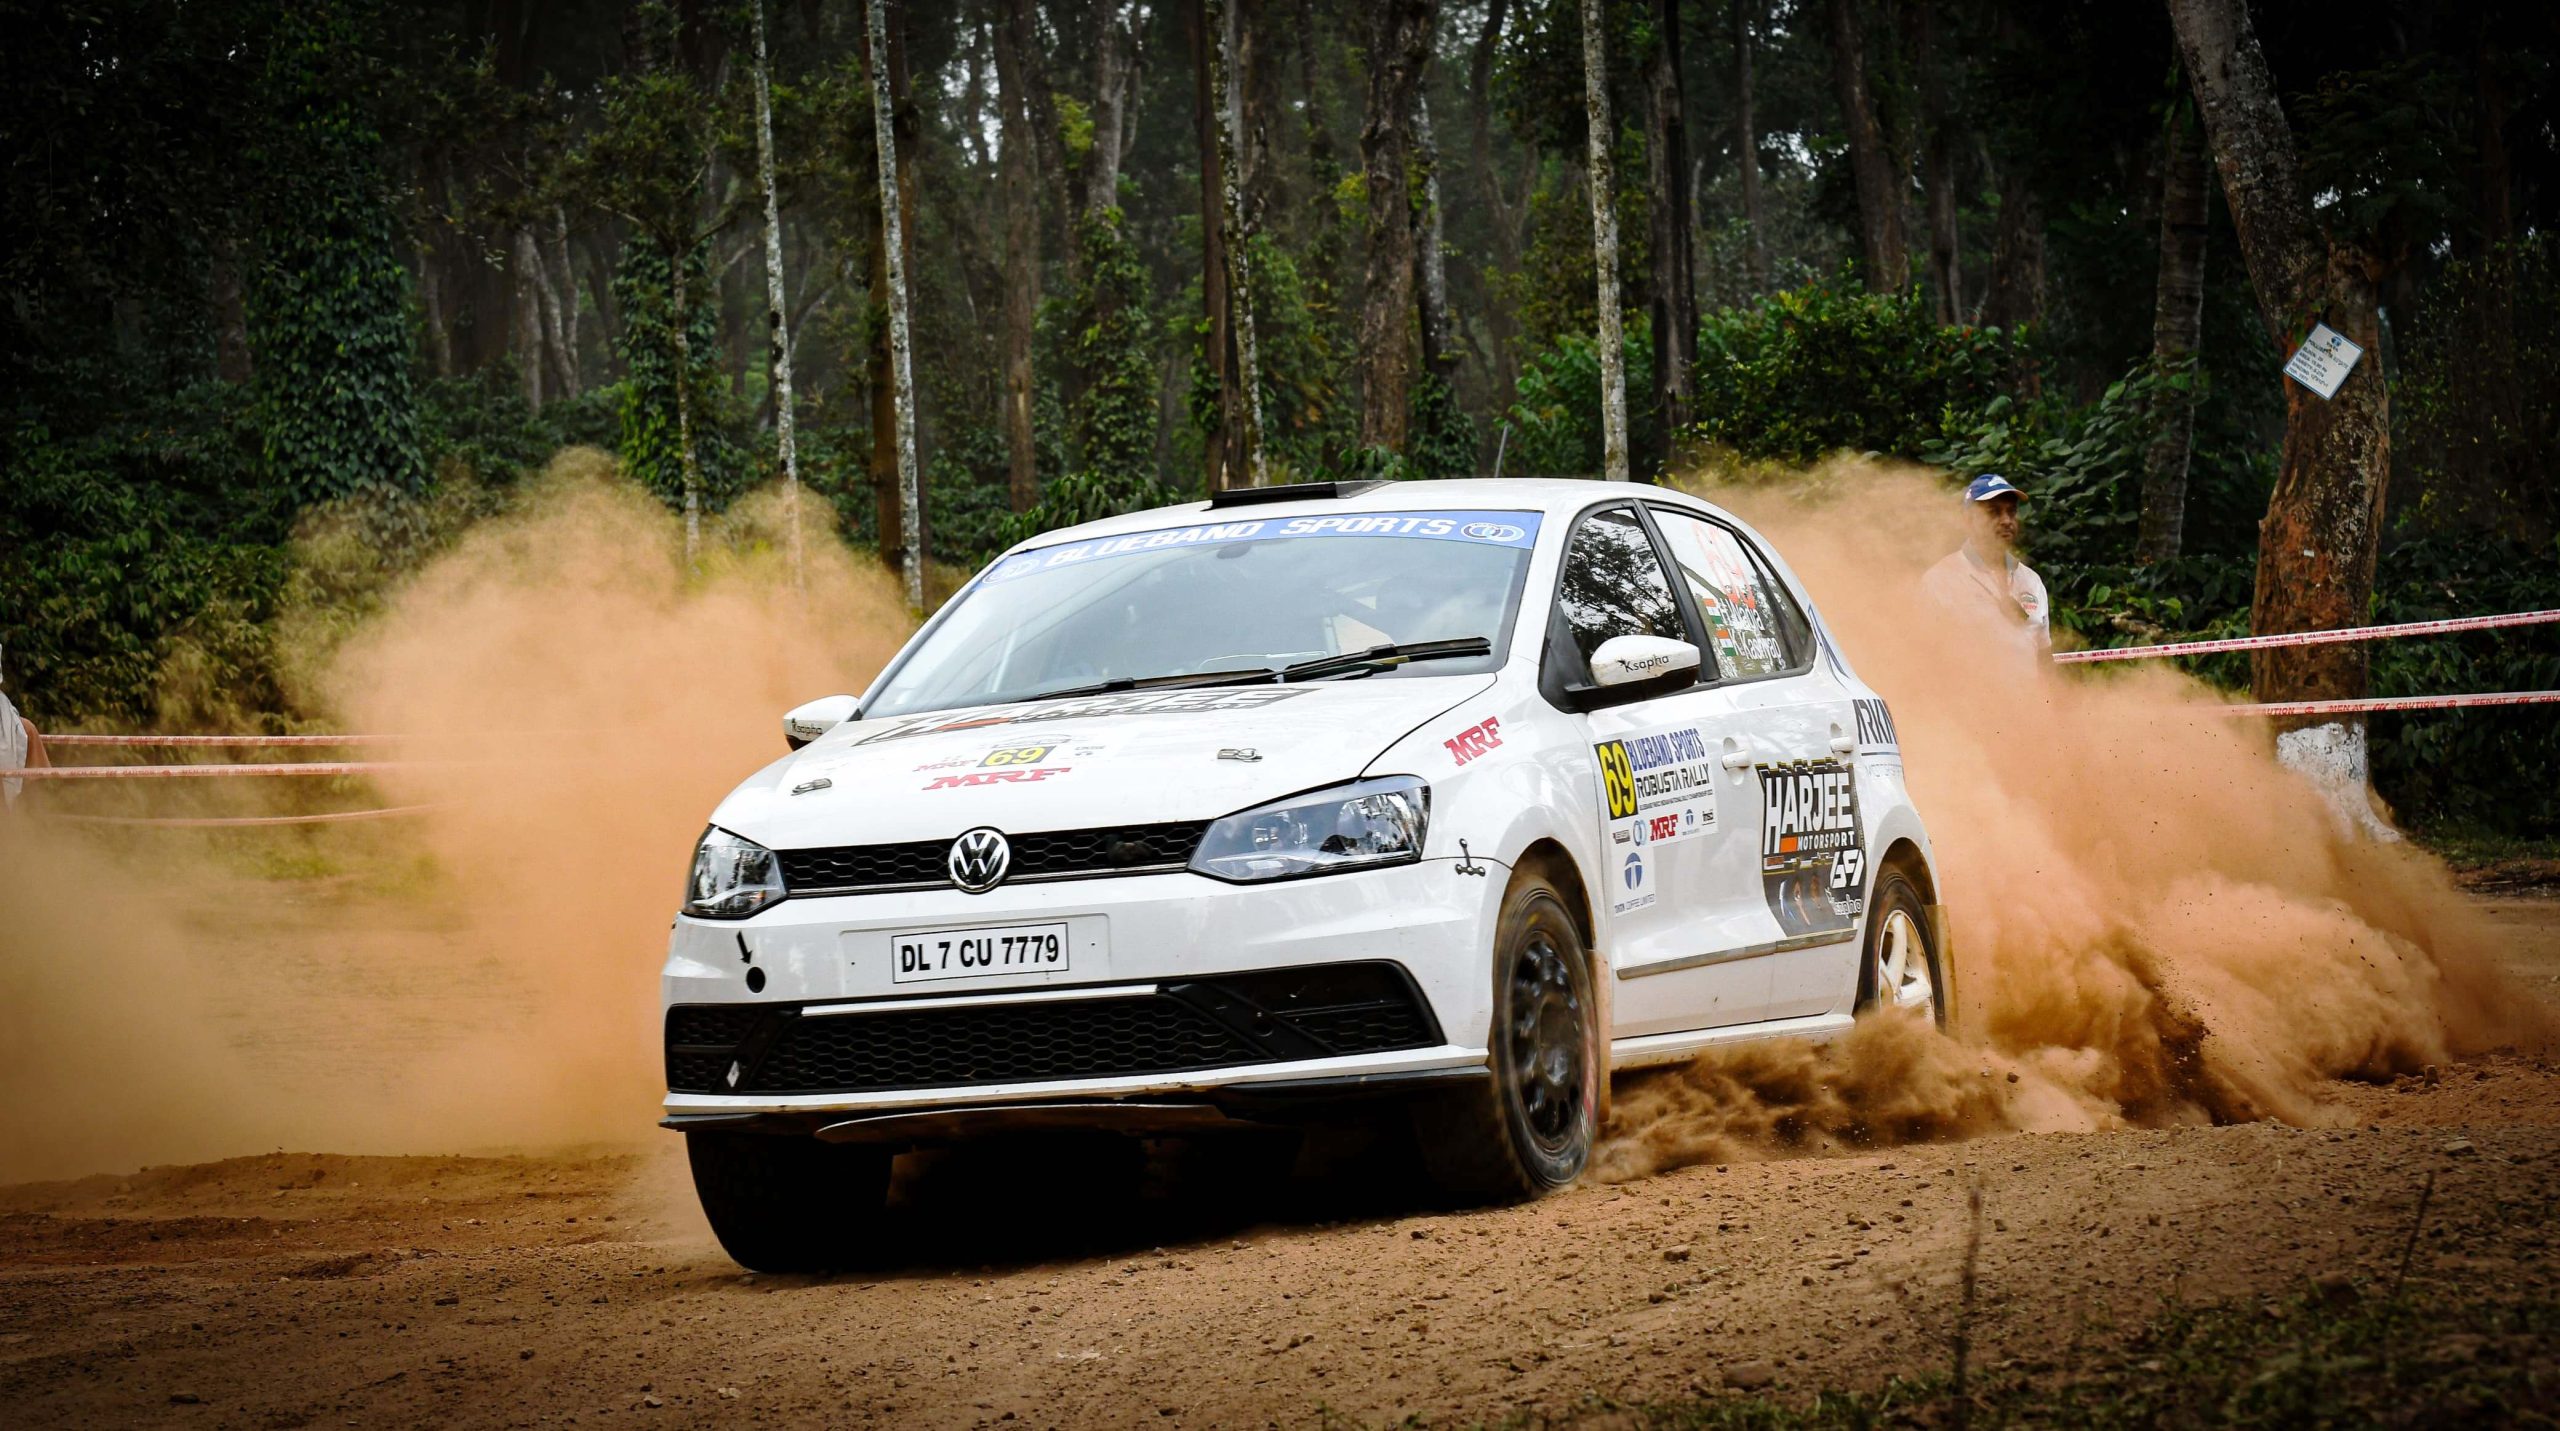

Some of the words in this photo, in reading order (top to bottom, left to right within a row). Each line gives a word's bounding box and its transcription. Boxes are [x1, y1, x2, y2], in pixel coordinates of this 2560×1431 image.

[1044, 522, 1266, 567] BLUEBAND
[1280, 517, 1457, 535] SPORTS
[2396, 701, 2437, 710] CAUTION
[2539, 695, 2560, 703] CAU
[985, 747, 1045, 766] 69
[1443, 716, 1503, 766] MRF
[1624, 734, 1673, 772] BLUEBAND
[1670, 728, 1706, 763] SPORTS
[922, 767, 1072, 791] MRF
[1599, 742, 1635, 817] 69
[1636, 770, 1681, 799] ROBUSTA
[1681, 763, 1710, 789] RALLY
[1650, 814, 1679, 841] MRF
[1763, 772, 1854, 855] HARJEE
[1798, 831, 1855, 851] MOTORSPORT
[901, 943, 930, 972] DL
[938, 942, 951, 969] 7
[960, 938, 992, 967] CU
[1001, 934, 1059, 964] 7779
